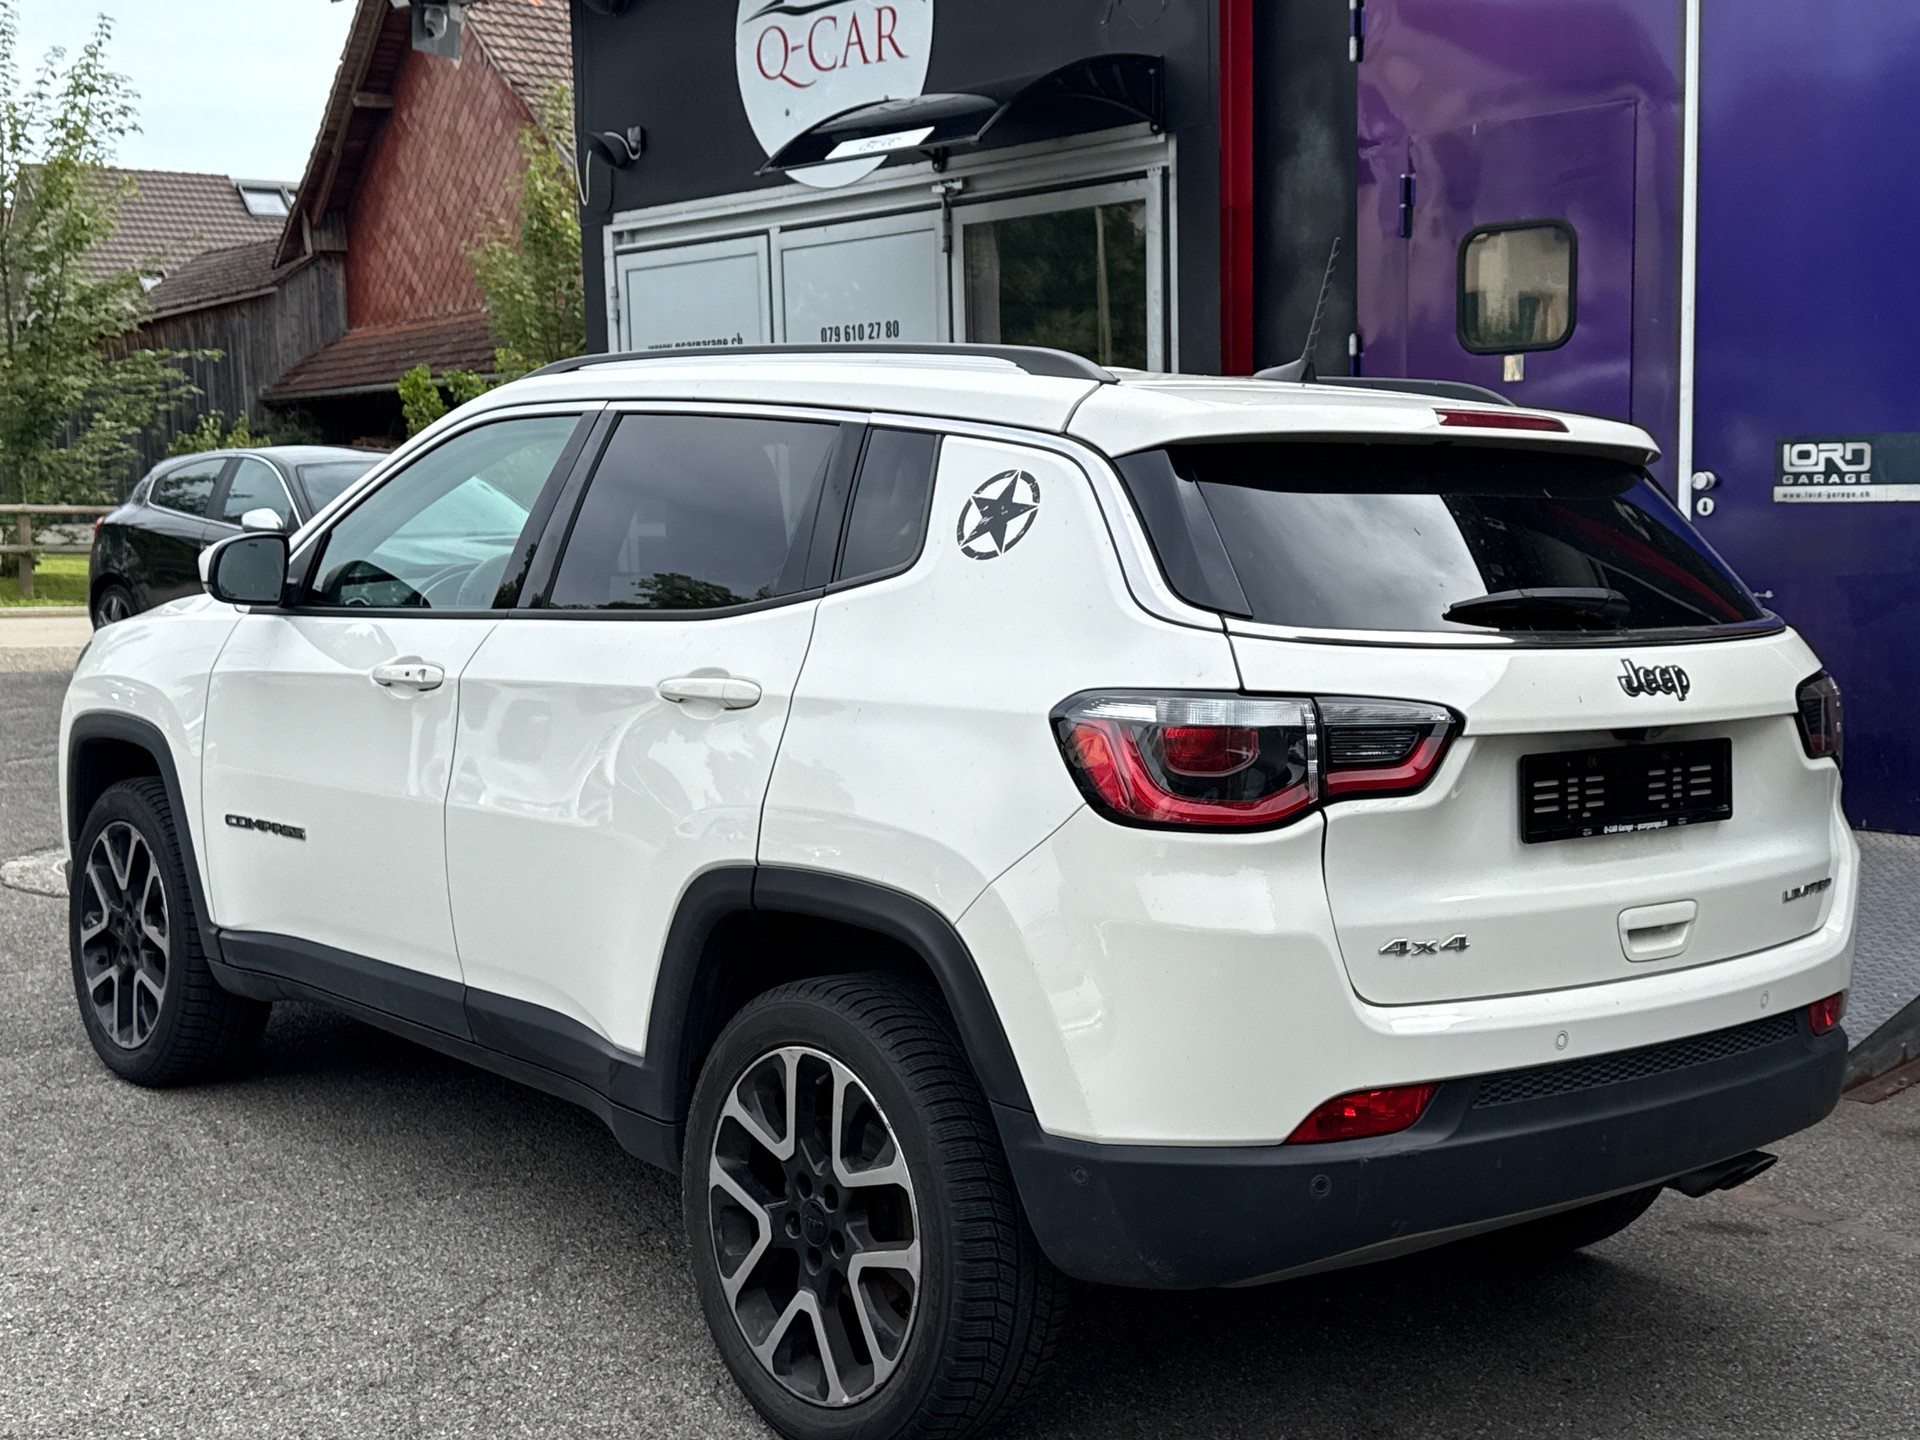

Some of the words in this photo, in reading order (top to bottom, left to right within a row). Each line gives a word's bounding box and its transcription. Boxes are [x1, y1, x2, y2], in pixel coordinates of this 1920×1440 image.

[756, 5, 909, 89] Q-CAR
[821, 326, 841, 342] 079
[844, 323, 865, 342] 610
[868, 322, 881, 340] 27
[885, 320, 900, 338] 80
[1783, 442, 1872, 472] LORD
[1783, 473, 1871, 484] GARAGE
[1782, 490, 1871, 499] www.lord-garage.ch
[1617, 658, 1690, 702] Jeep
[225, 814, 306, 841] COMPASS
[1379, 933, 1471, 956] 4x4
